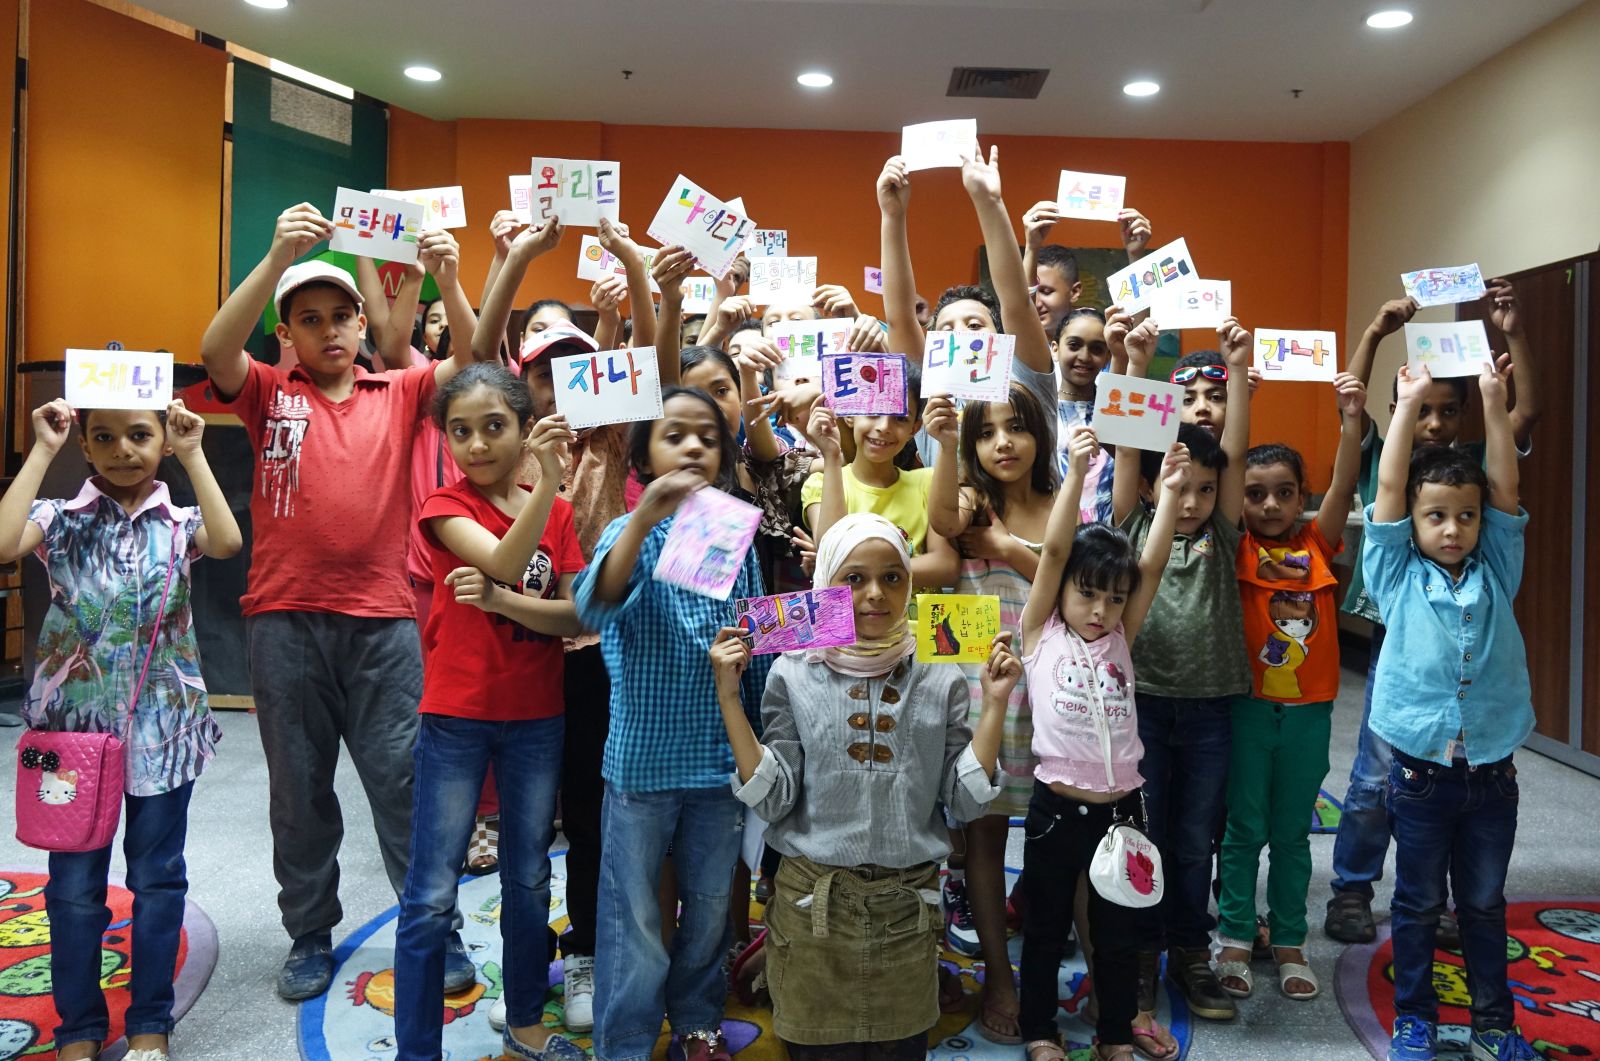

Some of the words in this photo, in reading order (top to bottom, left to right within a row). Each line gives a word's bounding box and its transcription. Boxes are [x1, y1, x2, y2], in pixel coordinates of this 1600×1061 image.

[678, 188, 748, 252] 나이라
[568, 352, 642, 396] 자나
[834, 357, 891, 398] 토아
[928, 333, 998, 383] 라완
[1260, 337, 1329, 371] 간나
[754, 592, 820, 645] 리합
